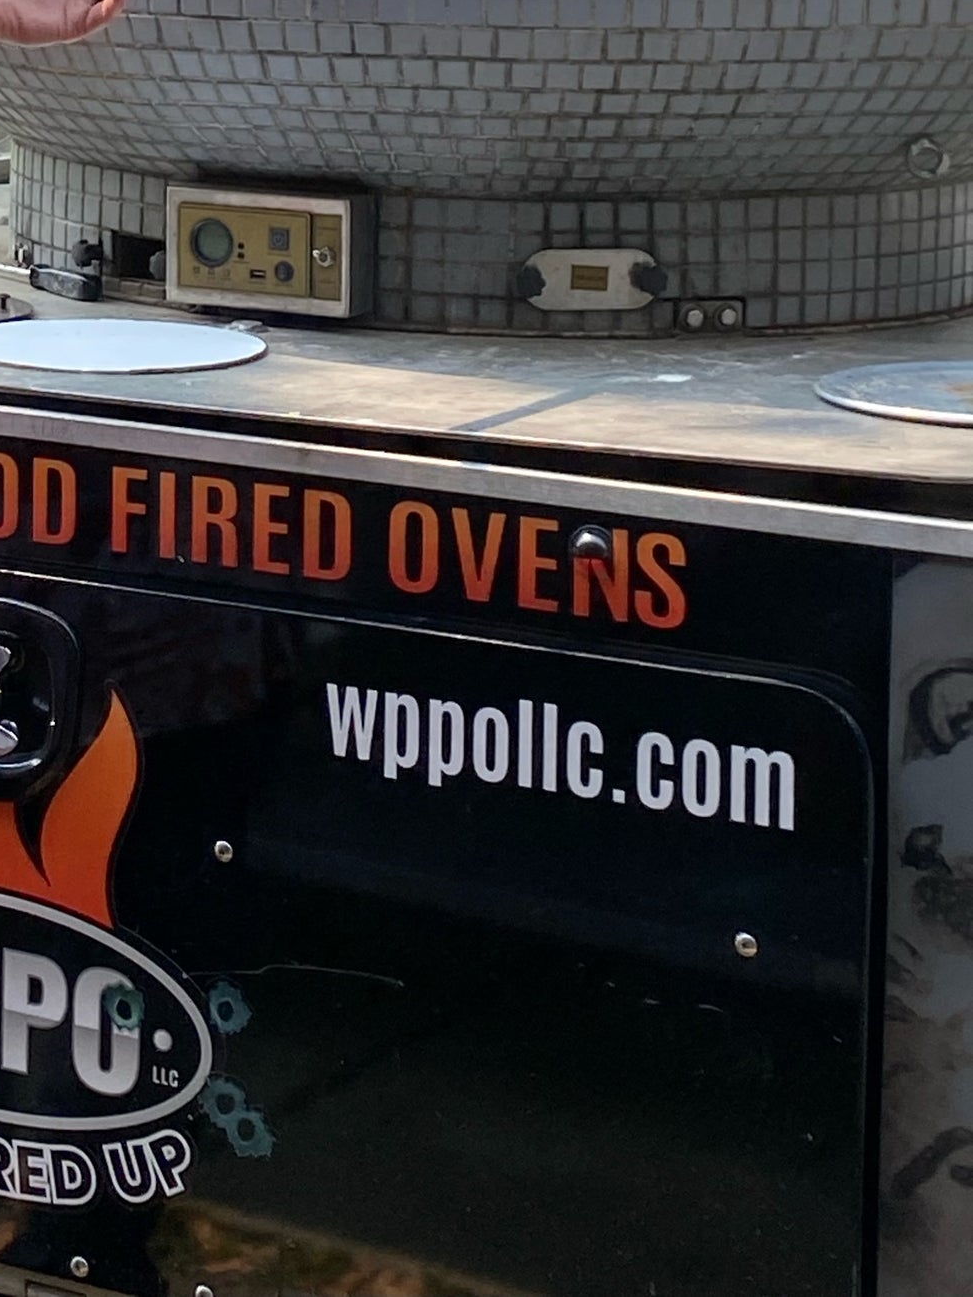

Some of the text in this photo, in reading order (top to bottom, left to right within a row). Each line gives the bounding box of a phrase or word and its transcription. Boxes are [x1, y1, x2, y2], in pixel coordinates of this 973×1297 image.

[110, 465, 352, 582] FIRED
[388, 501, 687, 630] OVENS
[326, 682, 795, 832] wppollc.com
[152, 1065, 179, 1088] LLC
[102, 1129, 191, 1204] UP
